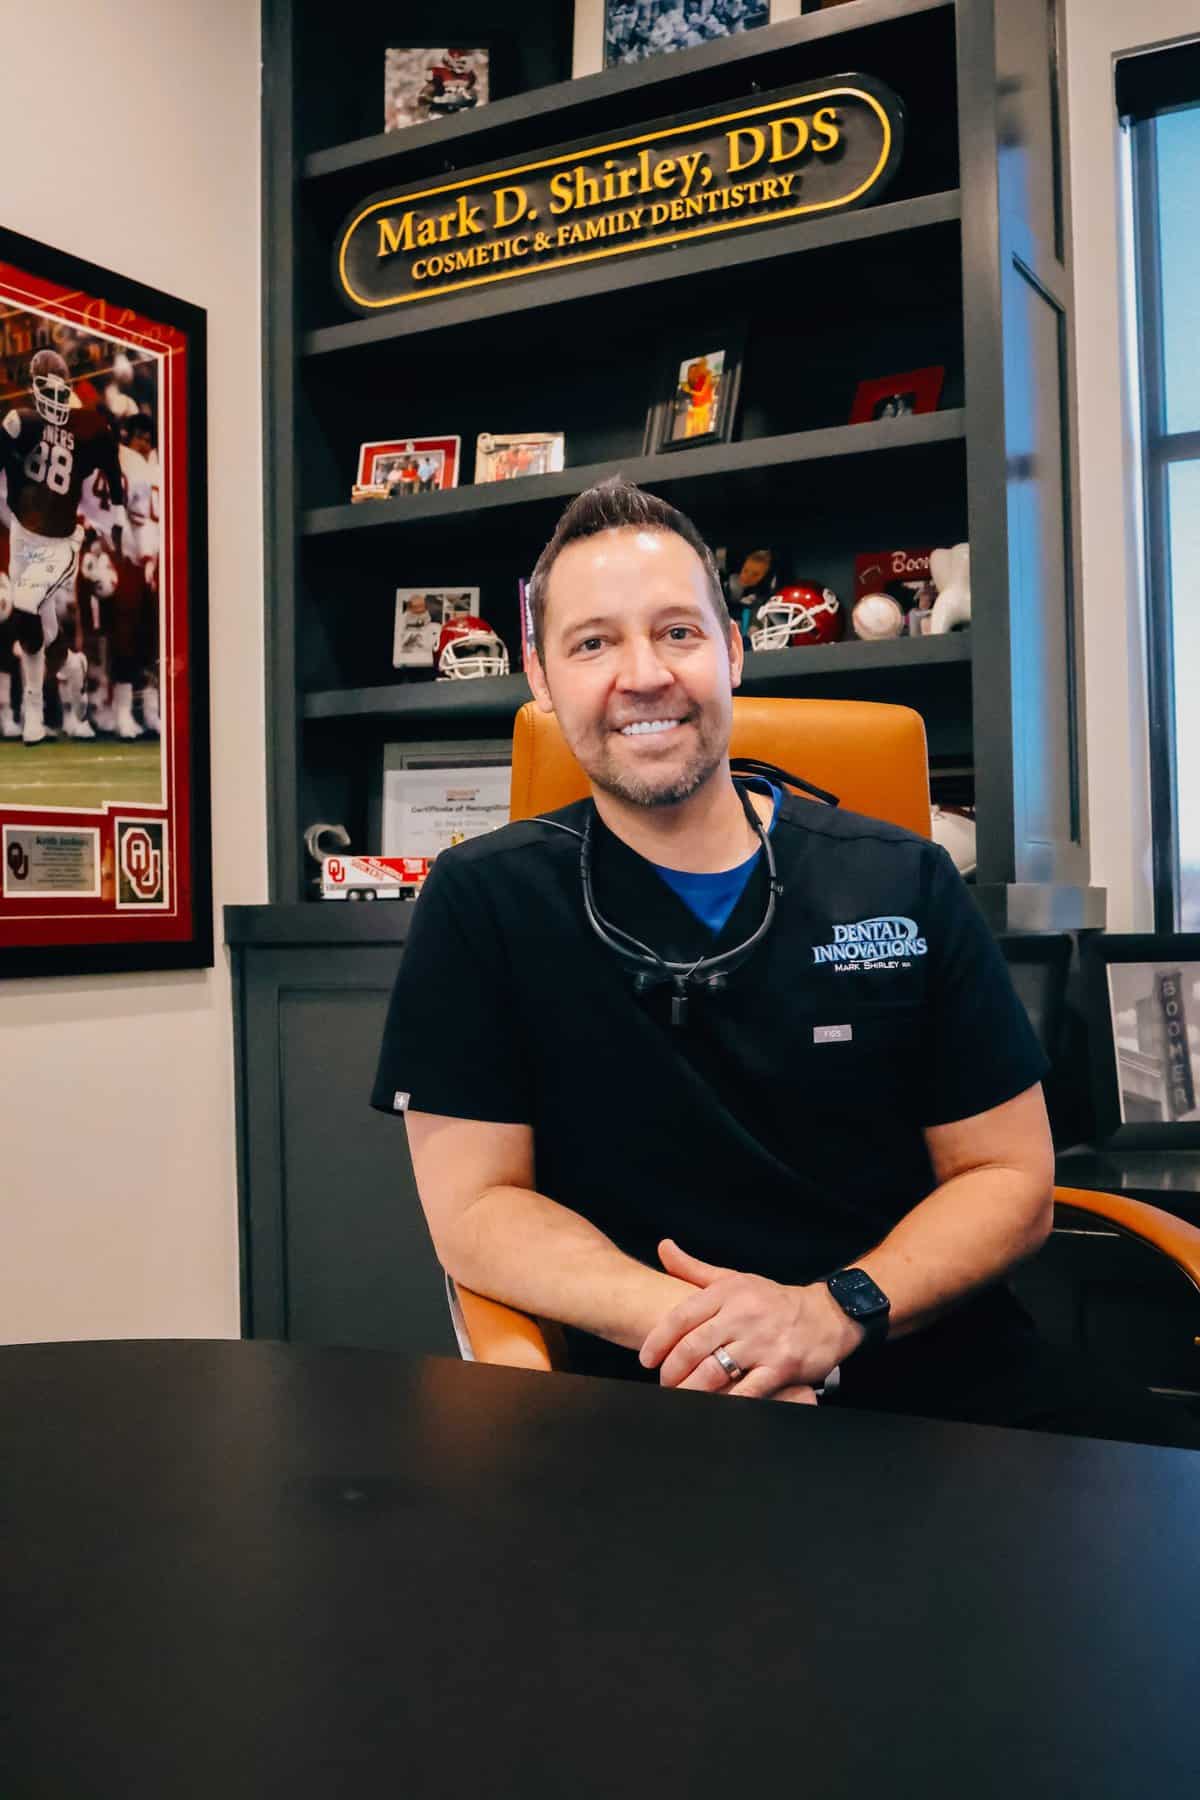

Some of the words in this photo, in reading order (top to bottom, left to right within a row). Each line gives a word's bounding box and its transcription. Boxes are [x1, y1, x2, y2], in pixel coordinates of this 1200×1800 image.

[376, 195, 484, 257] Mark
[492, 185, 538, 229] D.
[549, 150, 713, 215] Shirley,
[725, 107, 840, 173] DDS
[411, 235, 528, 280] COSMETIC
[533, 231, 551, 252] &
[557, 206, 644, 246] FAMILY
[651, 174, 795, 226] DENTISTRY
[25, 440, 73, 495] 88
[812, 938, 928, 963] INNOVATIONS
[832, 921, 908, 943] DENTAL
